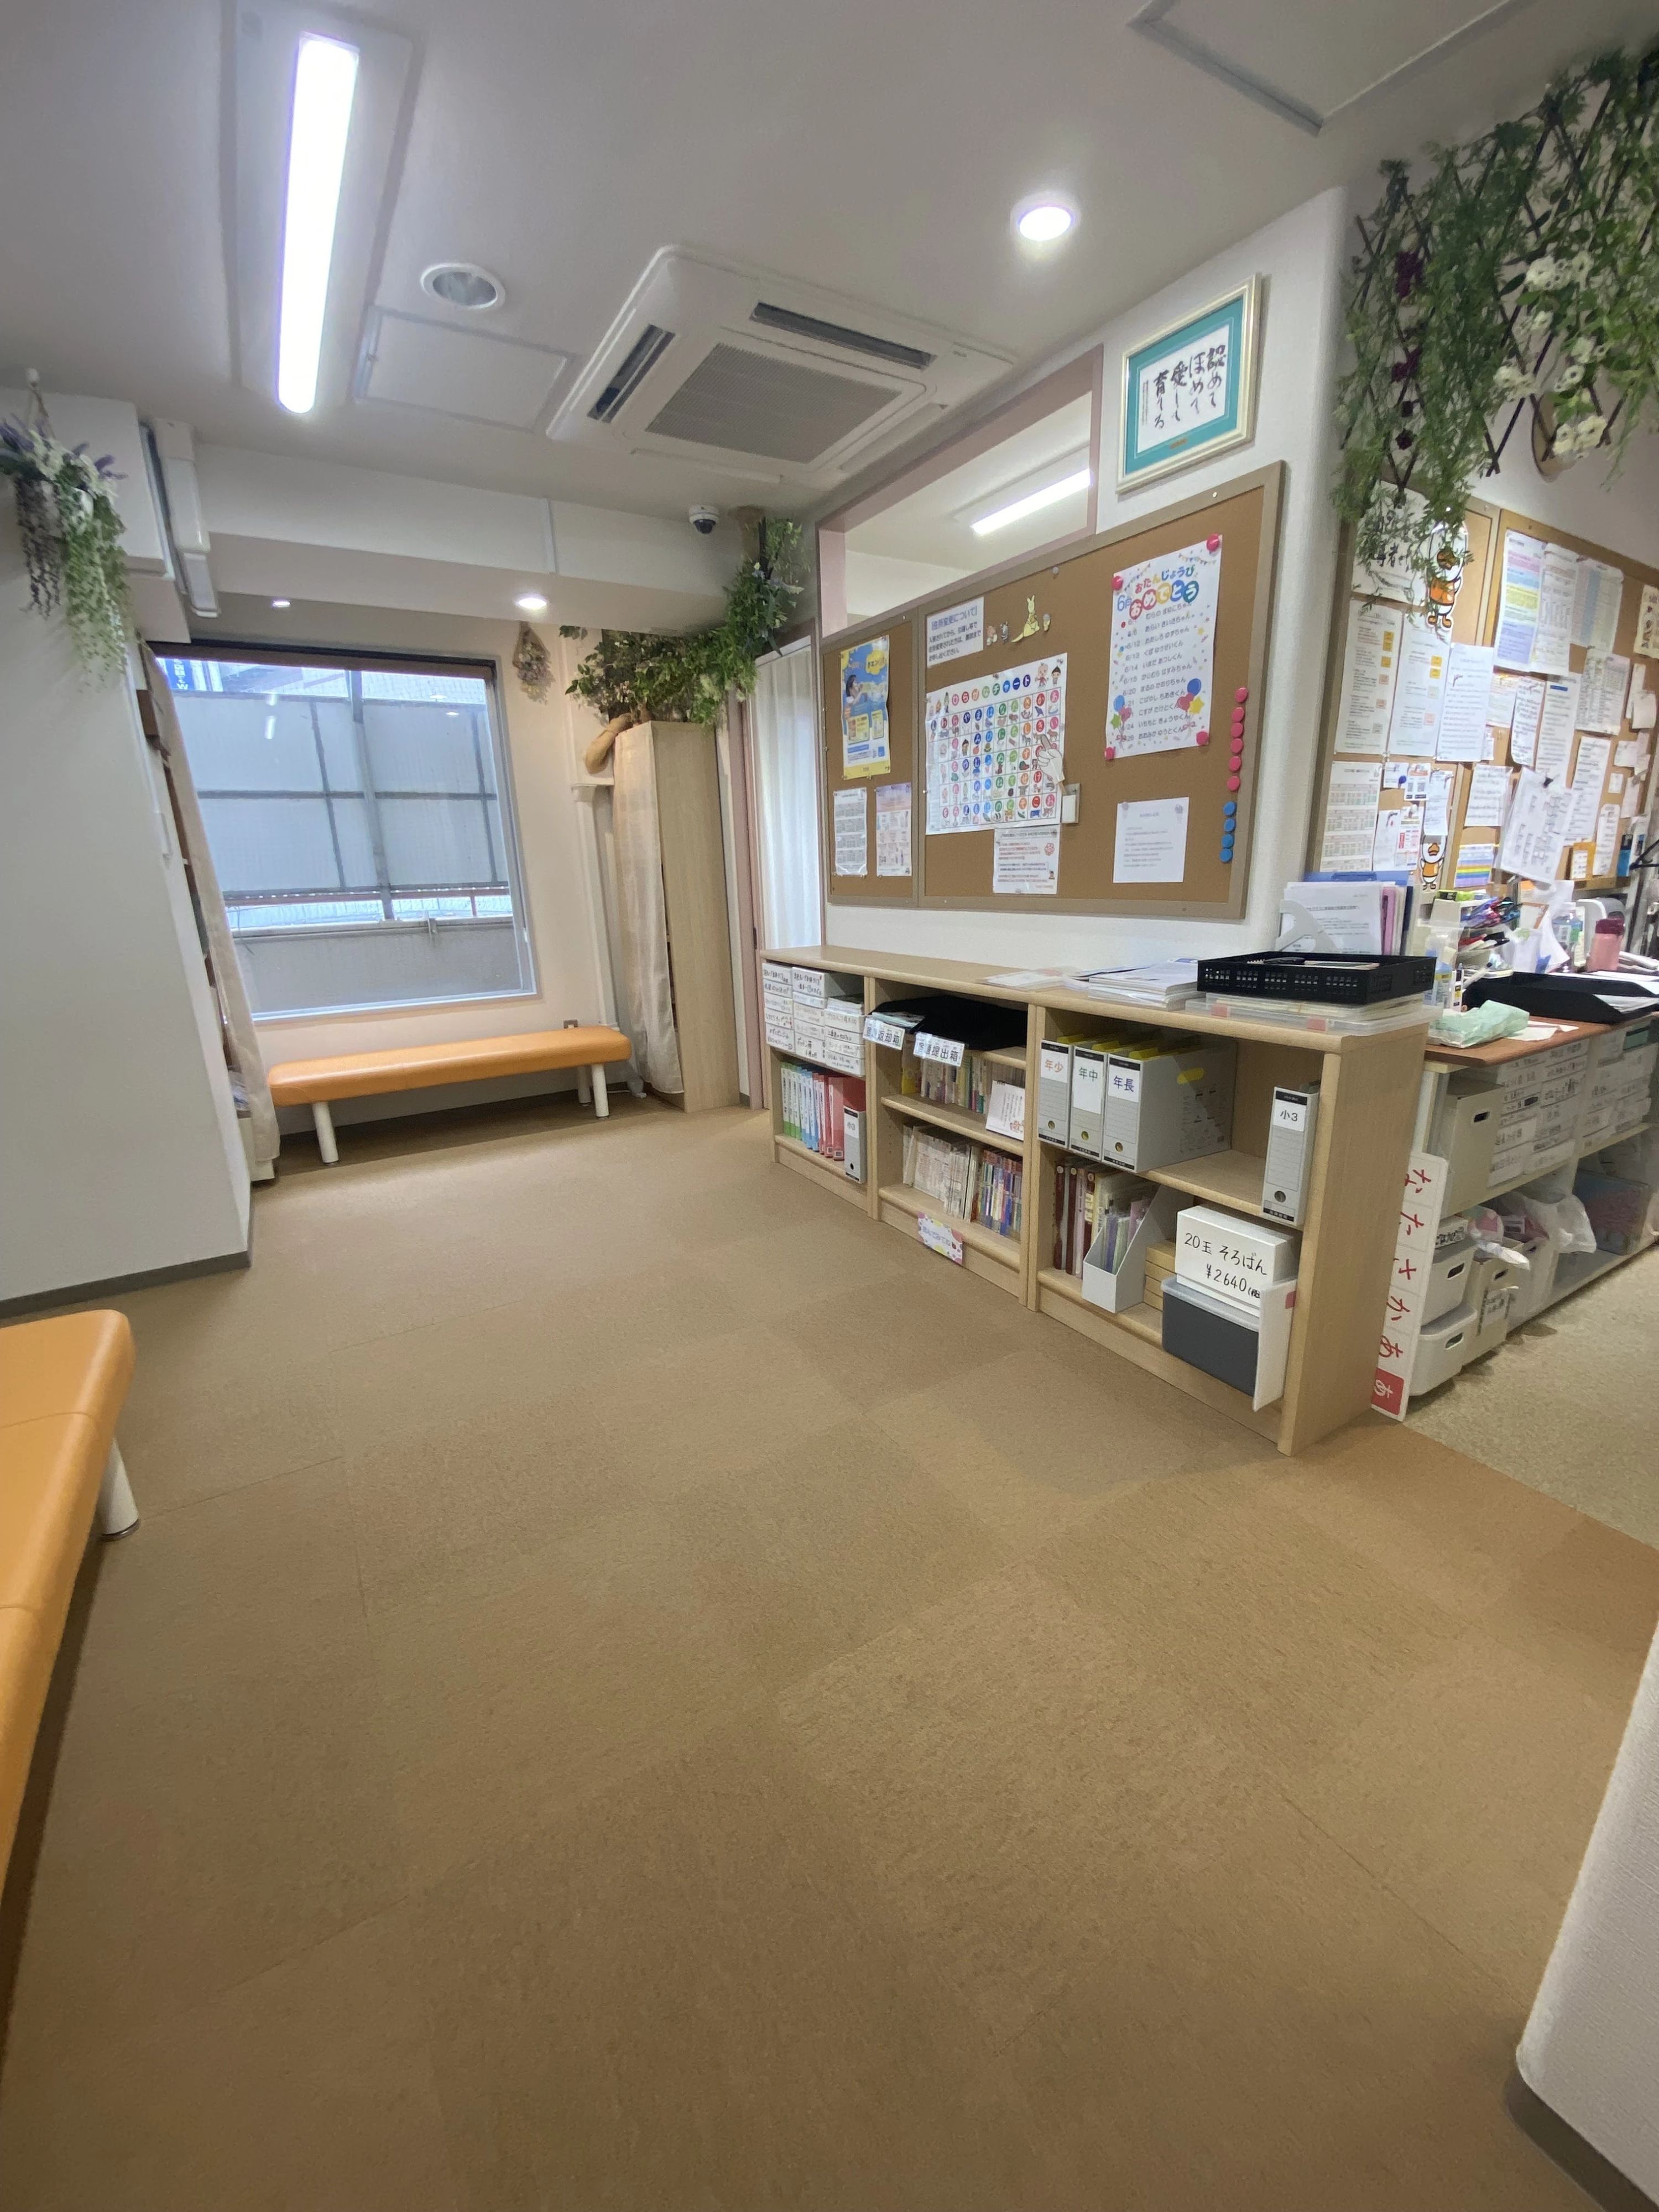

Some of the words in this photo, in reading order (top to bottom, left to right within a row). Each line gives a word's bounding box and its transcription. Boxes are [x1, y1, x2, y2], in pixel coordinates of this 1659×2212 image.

[1171, 360, 1189, 422] 愛して
[1189, 351, 1206, 416] ほめて
[1207, 344, 1226, 409] 認めて
[1135, 565, 1195, 594] おたんじょうび
[1045, 1059, 1064, 1073] 年少
[1078, 1066, 1098, 1082] 年中
[1113, 1075, 1134, 1092] 年長
[1280, 1109, 1298, 1121] 小3
[1185, 1233, 1212, 1255] 20玉
[1219, 1245, 1267, 1275] そろばん
